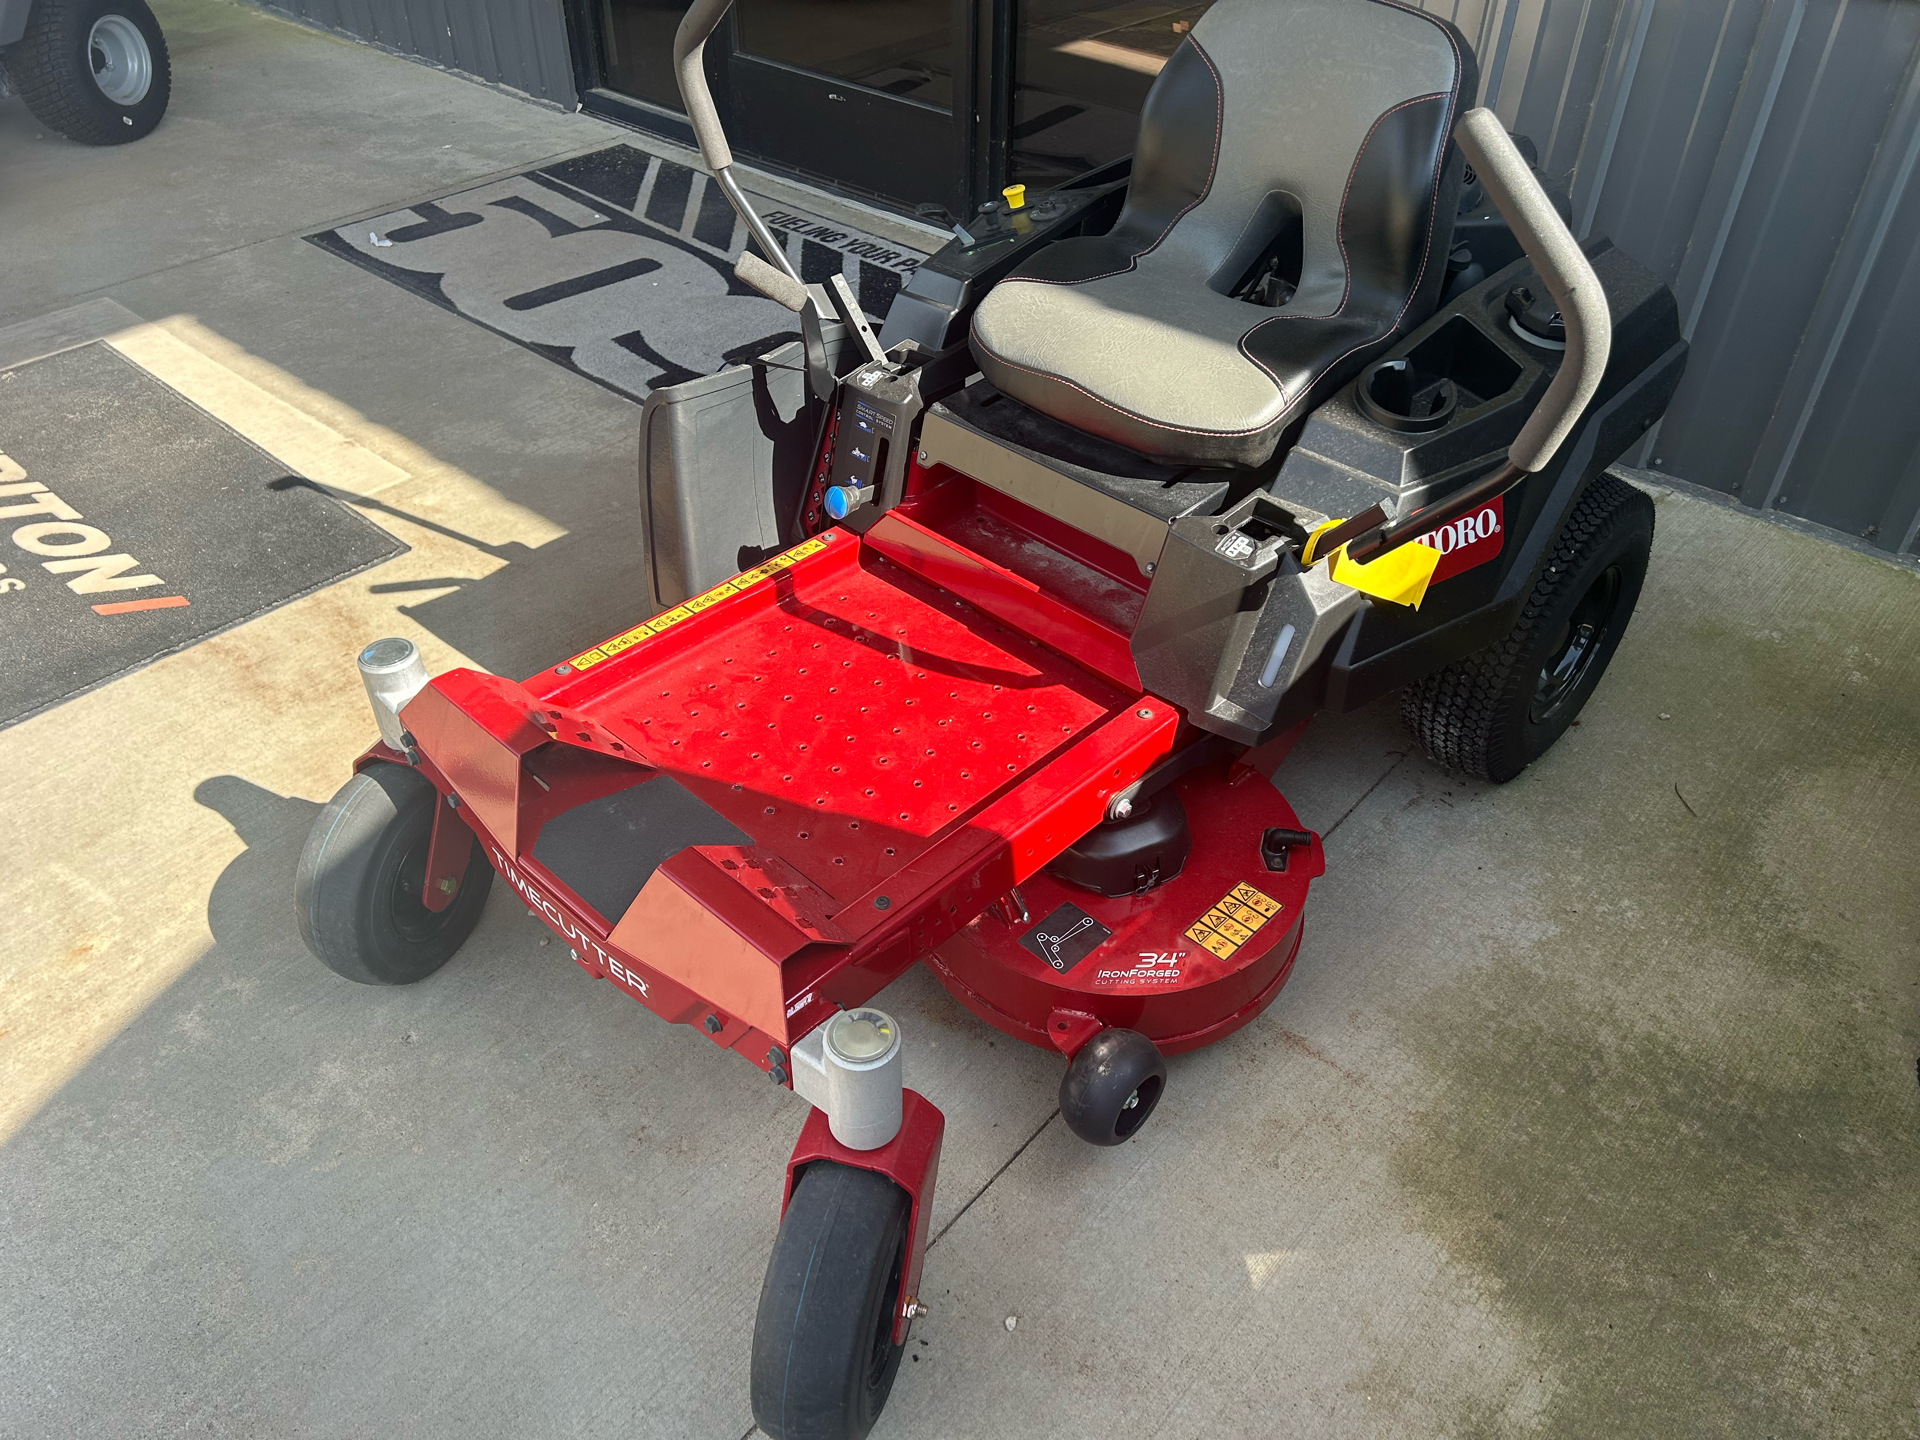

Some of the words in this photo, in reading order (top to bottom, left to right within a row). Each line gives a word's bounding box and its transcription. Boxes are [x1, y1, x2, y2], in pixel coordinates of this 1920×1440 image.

[761, 210, 849, 243] FUELING
[838, 238, 903, 269] YOUR
[855, 409, 874, 421] CONTROL
[875, 419, 892, 430] SYSTEM
[856, 403, 876, 417] SMART
[876, 412, 894, 424] SPEED
[0, 455, 166, 594] ITON
[1413, 508, 1497, 555] TORO
[491, 846, 649, 999] TIMECUTTER
[1135, 952, 1186, 968] 34"
